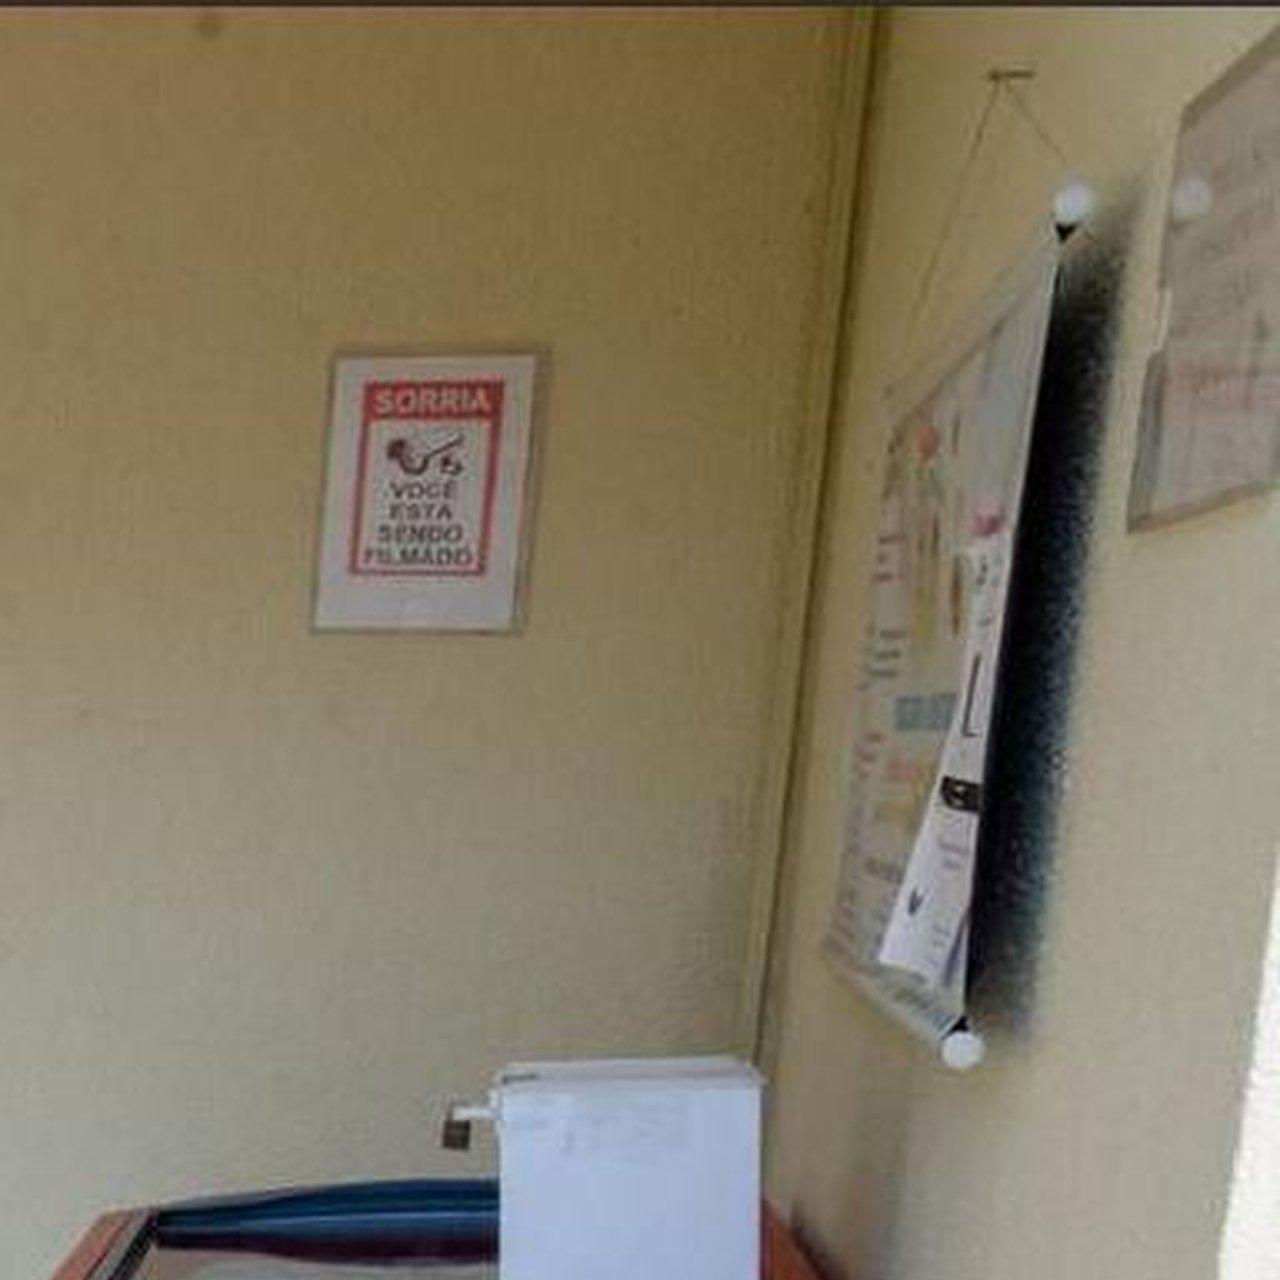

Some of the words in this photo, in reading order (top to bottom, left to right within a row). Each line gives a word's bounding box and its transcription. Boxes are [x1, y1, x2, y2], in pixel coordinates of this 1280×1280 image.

[374, 387, 491, 414] SORRIA
[378, 525, 462, 543] SENDO
[364, 547, 472, 567] FILMADO
